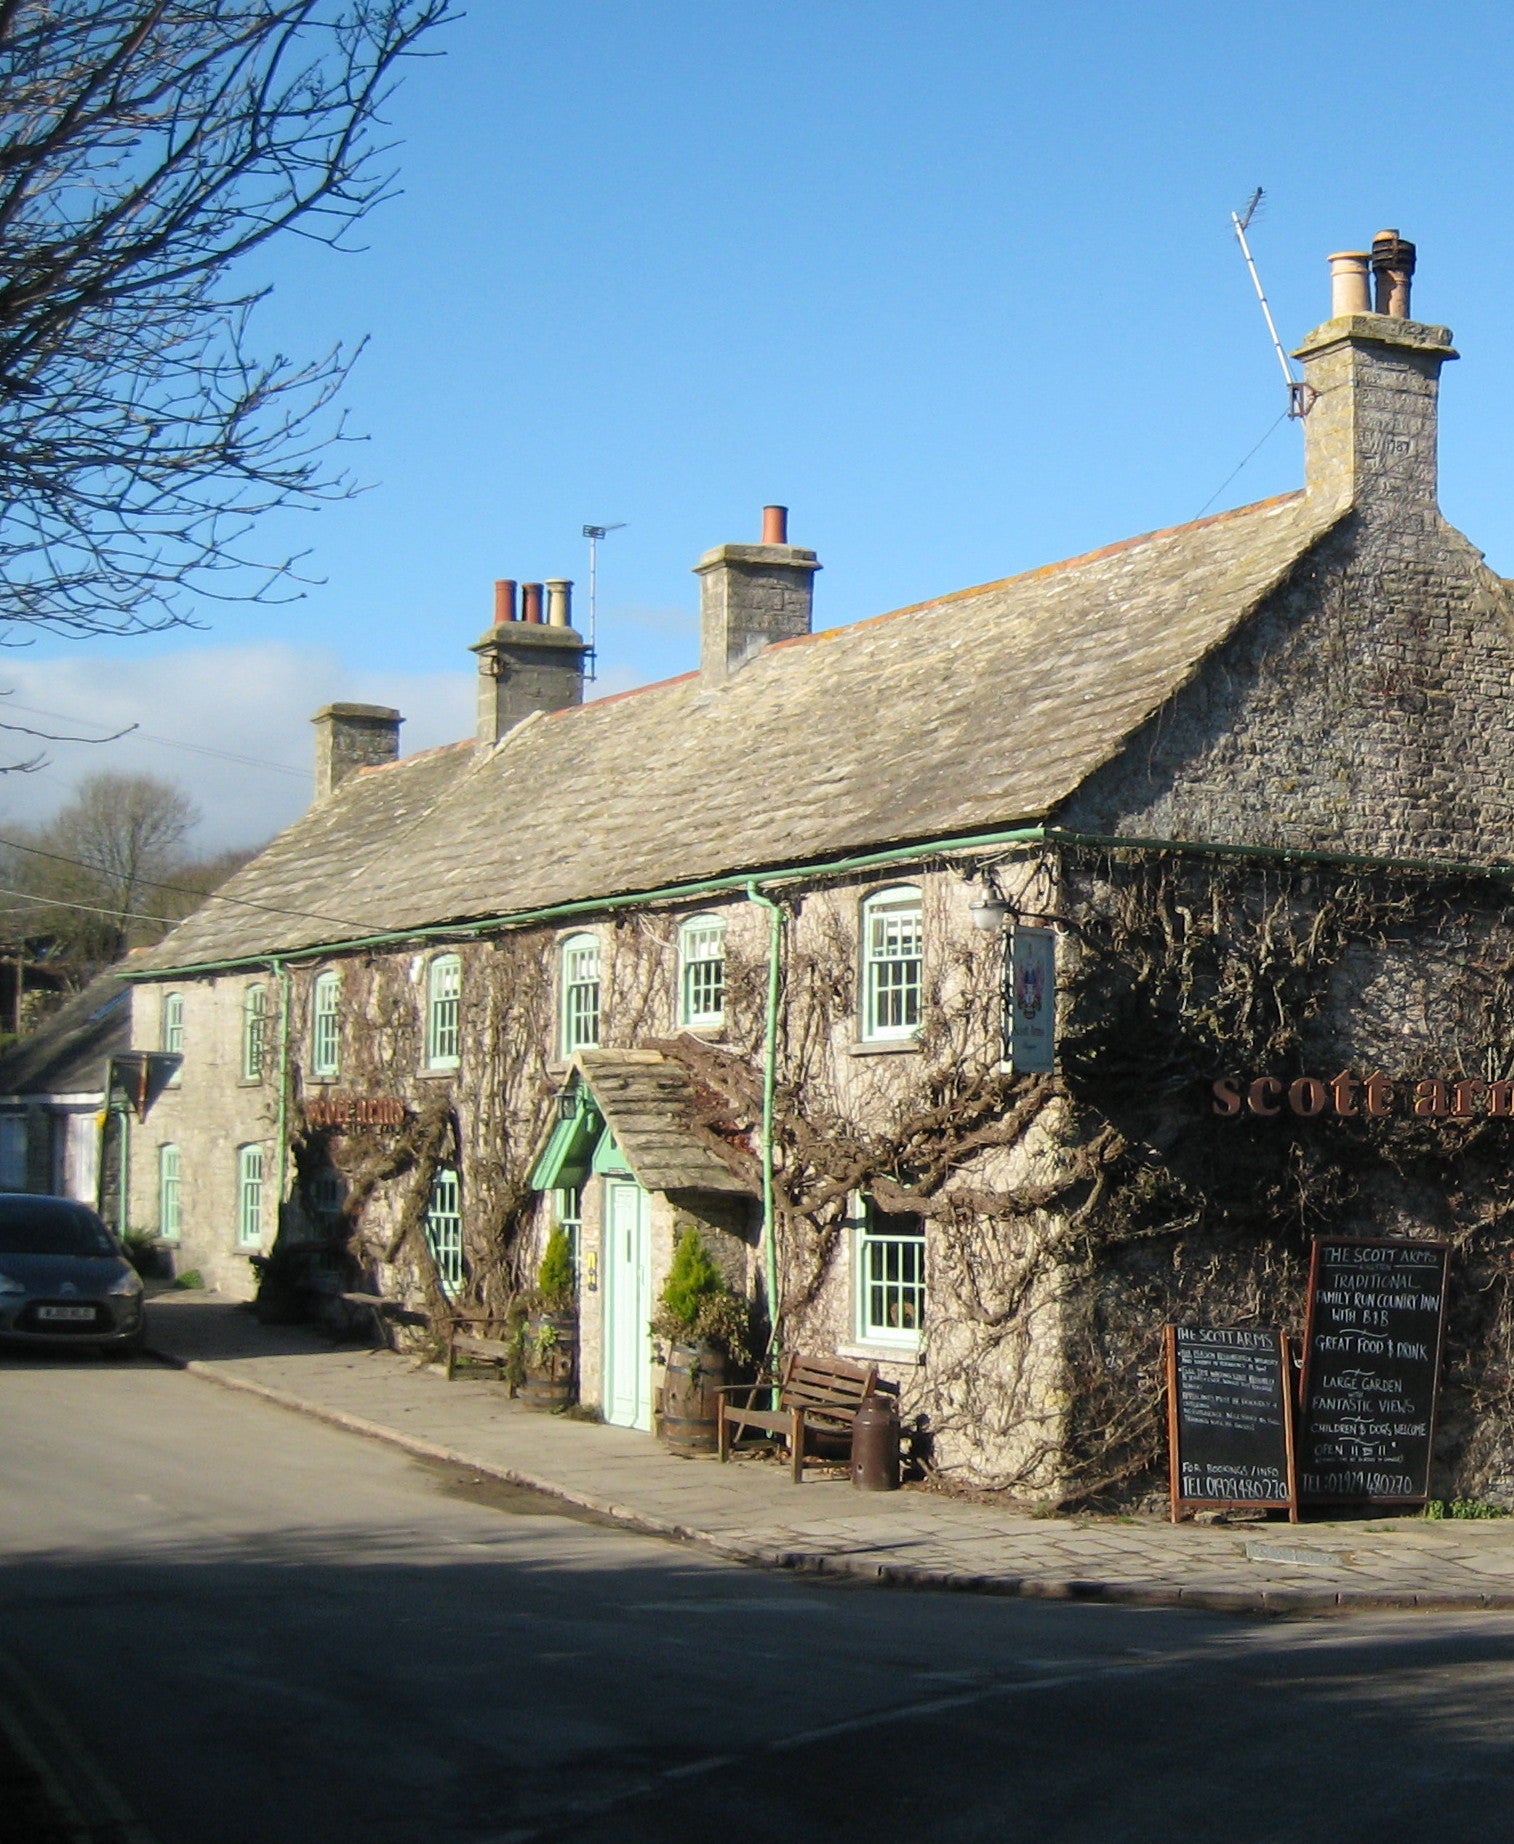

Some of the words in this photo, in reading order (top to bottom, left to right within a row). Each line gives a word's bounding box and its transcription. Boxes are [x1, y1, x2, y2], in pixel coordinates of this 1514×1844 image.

[1212, 1068, 1394, 1117] scott
[1353, 1248, 1396, 1263] SCOTT
[1334, 1273, 1421, 1290] TRADITIONAL
[1316, 1290, 1350, 1306] FAMILY
[1354, 1292, 1375, 1308] RUN
[1332, 1308, 1356, 1323] WITH
[1199, 1328, 1233, 1344] SCOTT
[1236, 1330, 1274, 1348] ARMS
[1315, 1334, 1352, 1353] GREAT
[1357, 1338, 1384, 1354] FOOD
[1397, 1342, 1428, 1362] DRINK
[1323, 1375, 1358, 1390] LARGE
[1361, 1377, 1402, 1393] GARDEN
[1312, 1396, 1374, 1413] FANTASTIC
[1379, 1399, 1415, 1414] VIEWS
[1311, 1422, 1357, 1435] CHILDREN
[1369, 1423, 1392, 1437] DOGS
[1393, 1423, 1427, 1437] WELCOME
[1182, 1461, 1201, 1473] FOR
